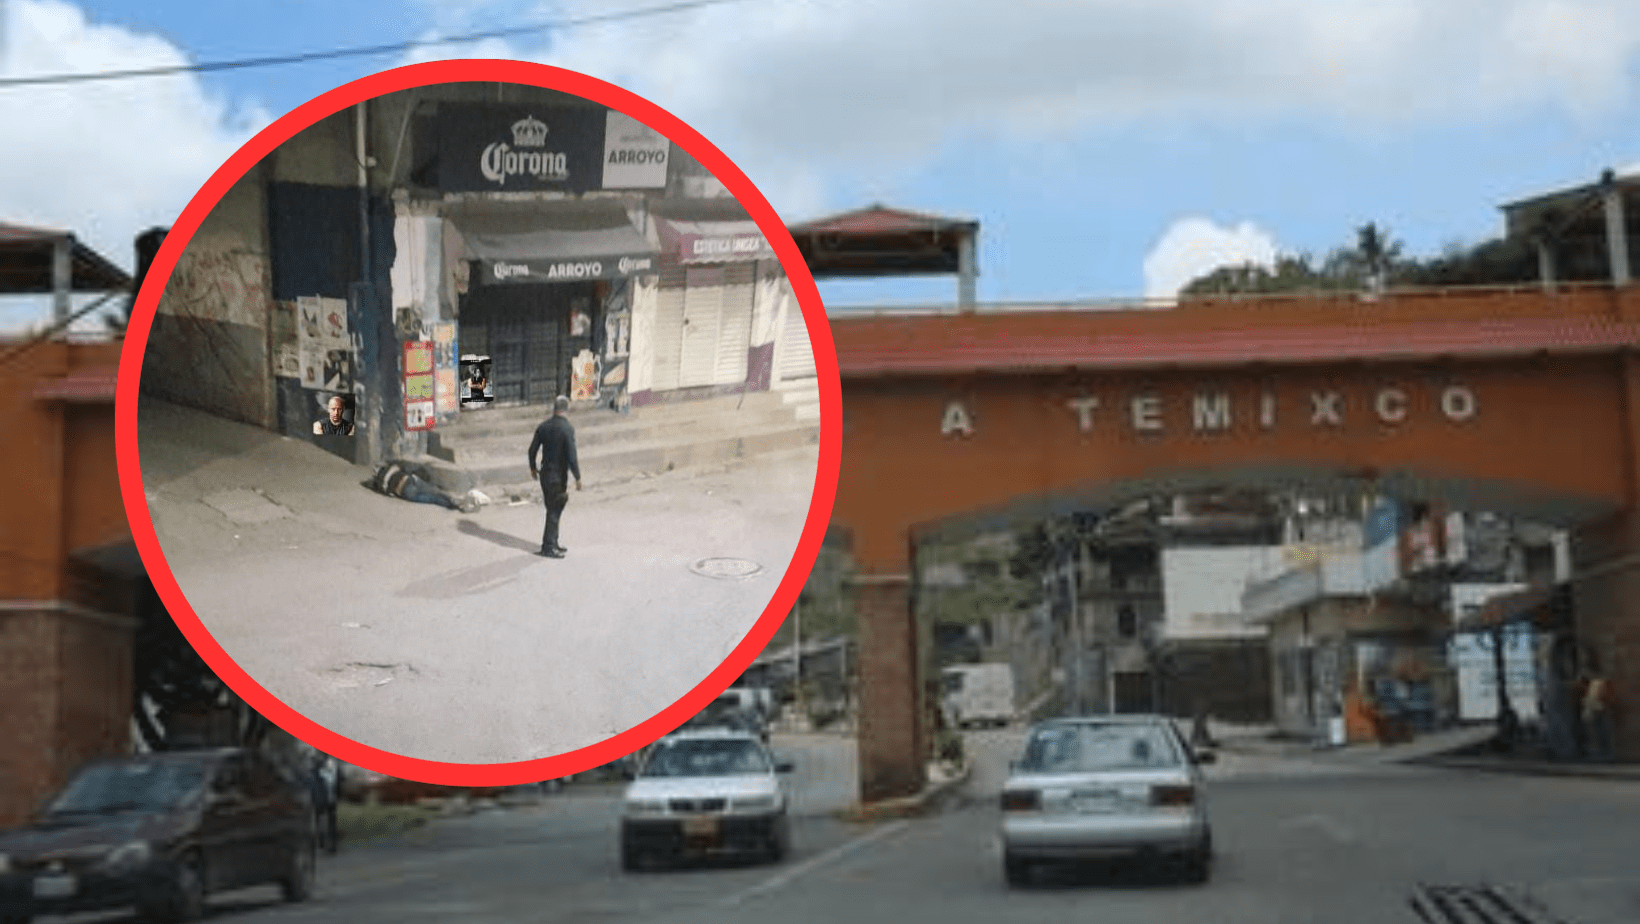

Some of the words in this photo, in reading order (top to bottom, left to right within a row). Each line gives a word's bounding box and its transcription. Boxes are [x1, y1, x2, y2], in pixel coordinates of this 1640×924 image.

[481, 142, 567, 185] Corona
[608, 150, 665, 164] ARROYO
[494, 262, 529, 280] Corona
[548, 262, 602, 277] ARROYO
[941, 403, 974, 434] A
[1069, 387, 1475, 431] TEMIXCO
